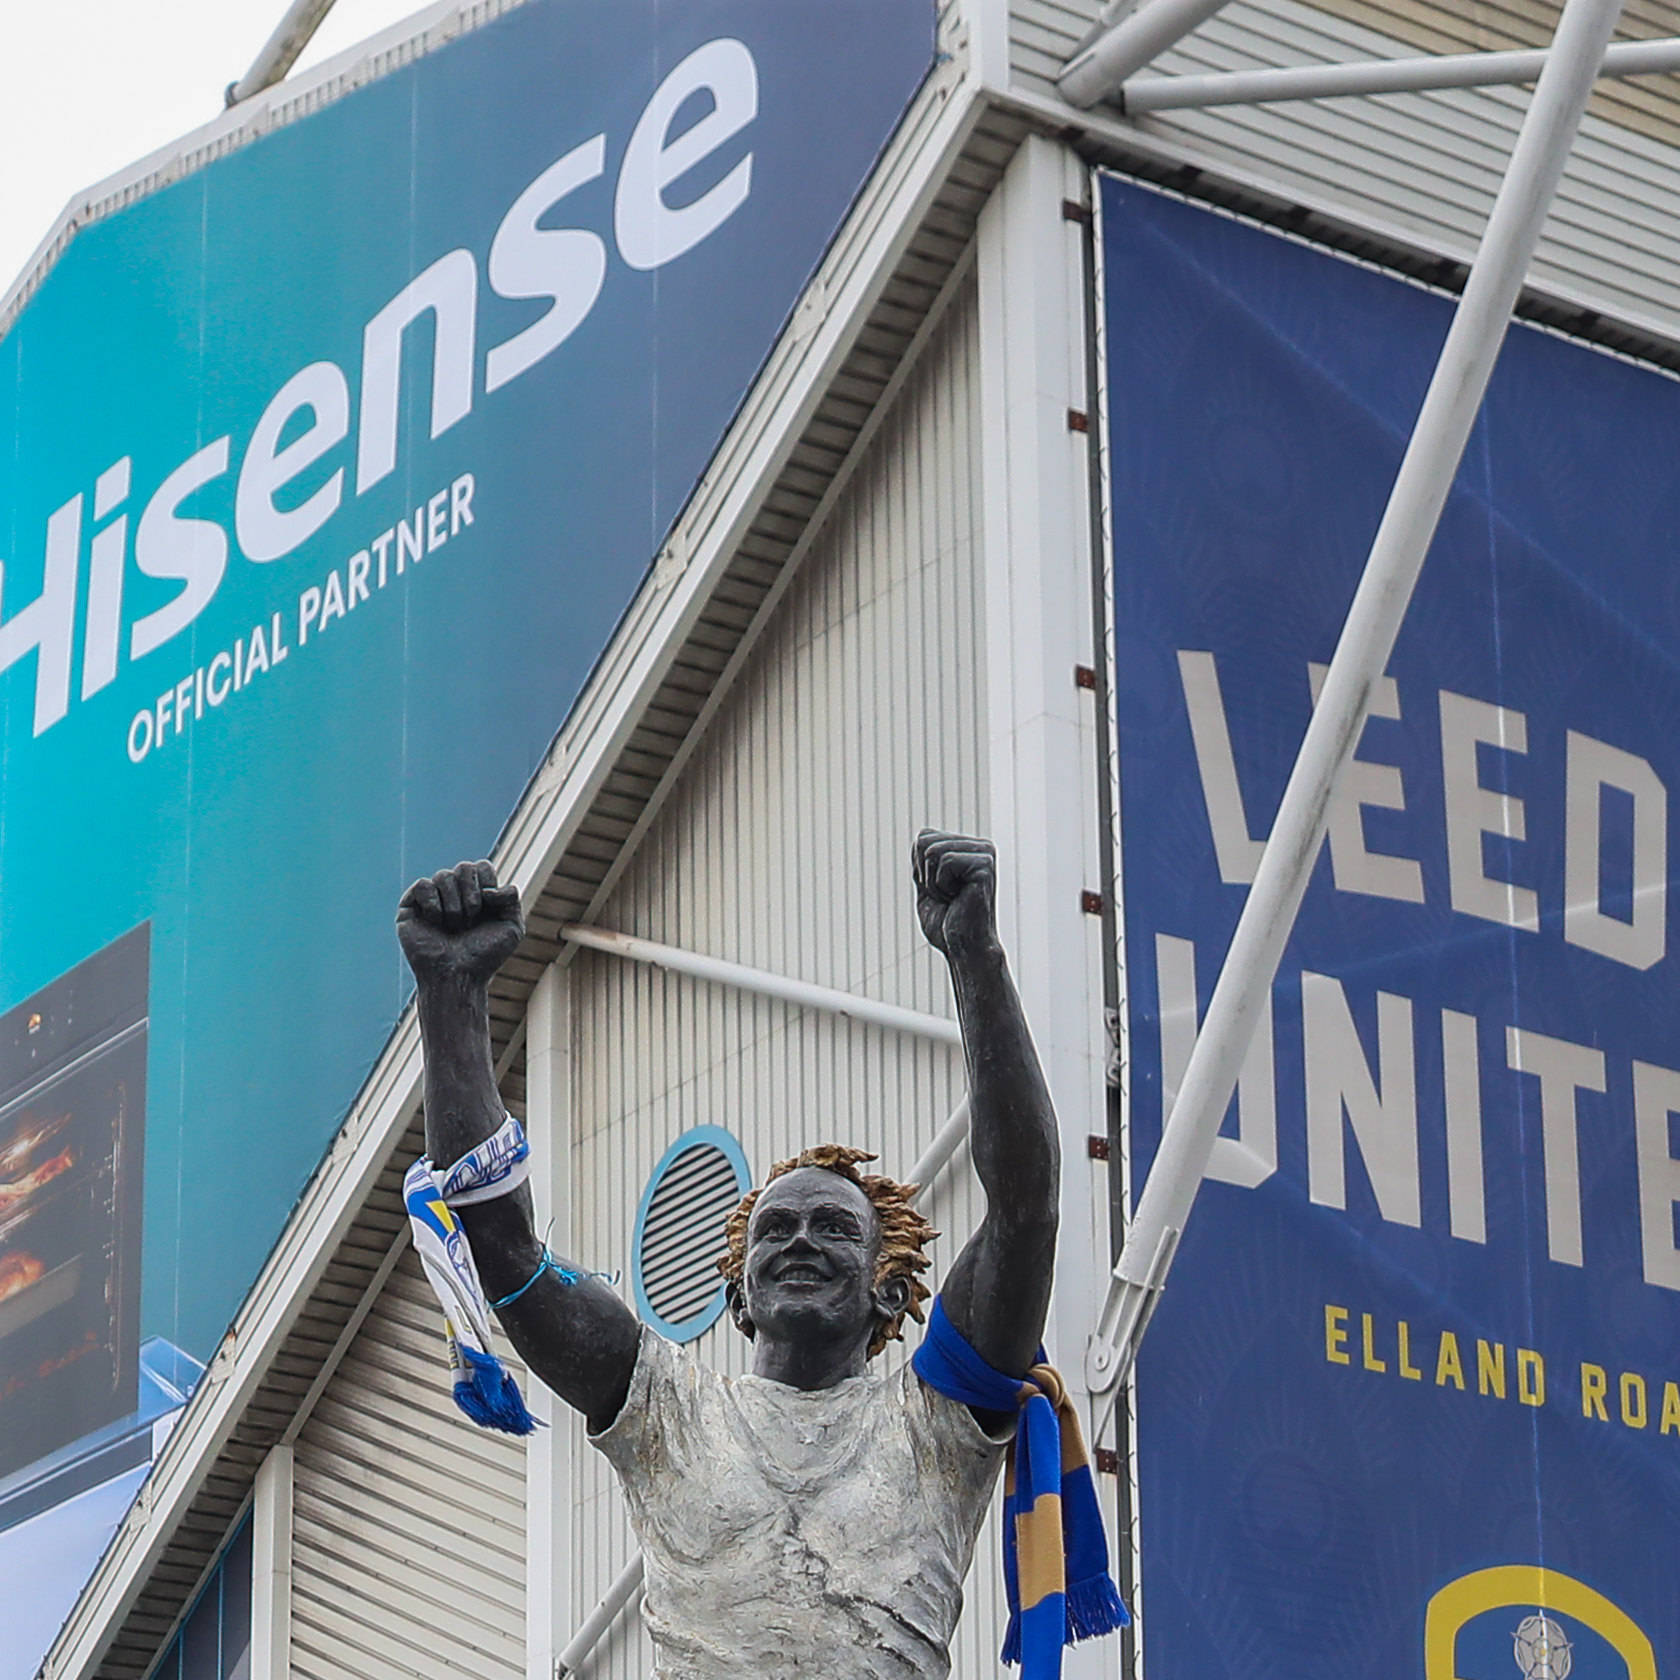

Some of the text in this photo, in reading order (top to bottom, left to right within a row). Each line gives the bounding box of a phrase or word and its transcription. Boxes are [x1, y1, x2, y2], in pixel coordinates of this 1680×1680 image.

[127, 472, 475, 763] OFFICIAL PARTNER
[1325, 1305, 1545, 1407] ELLAND
